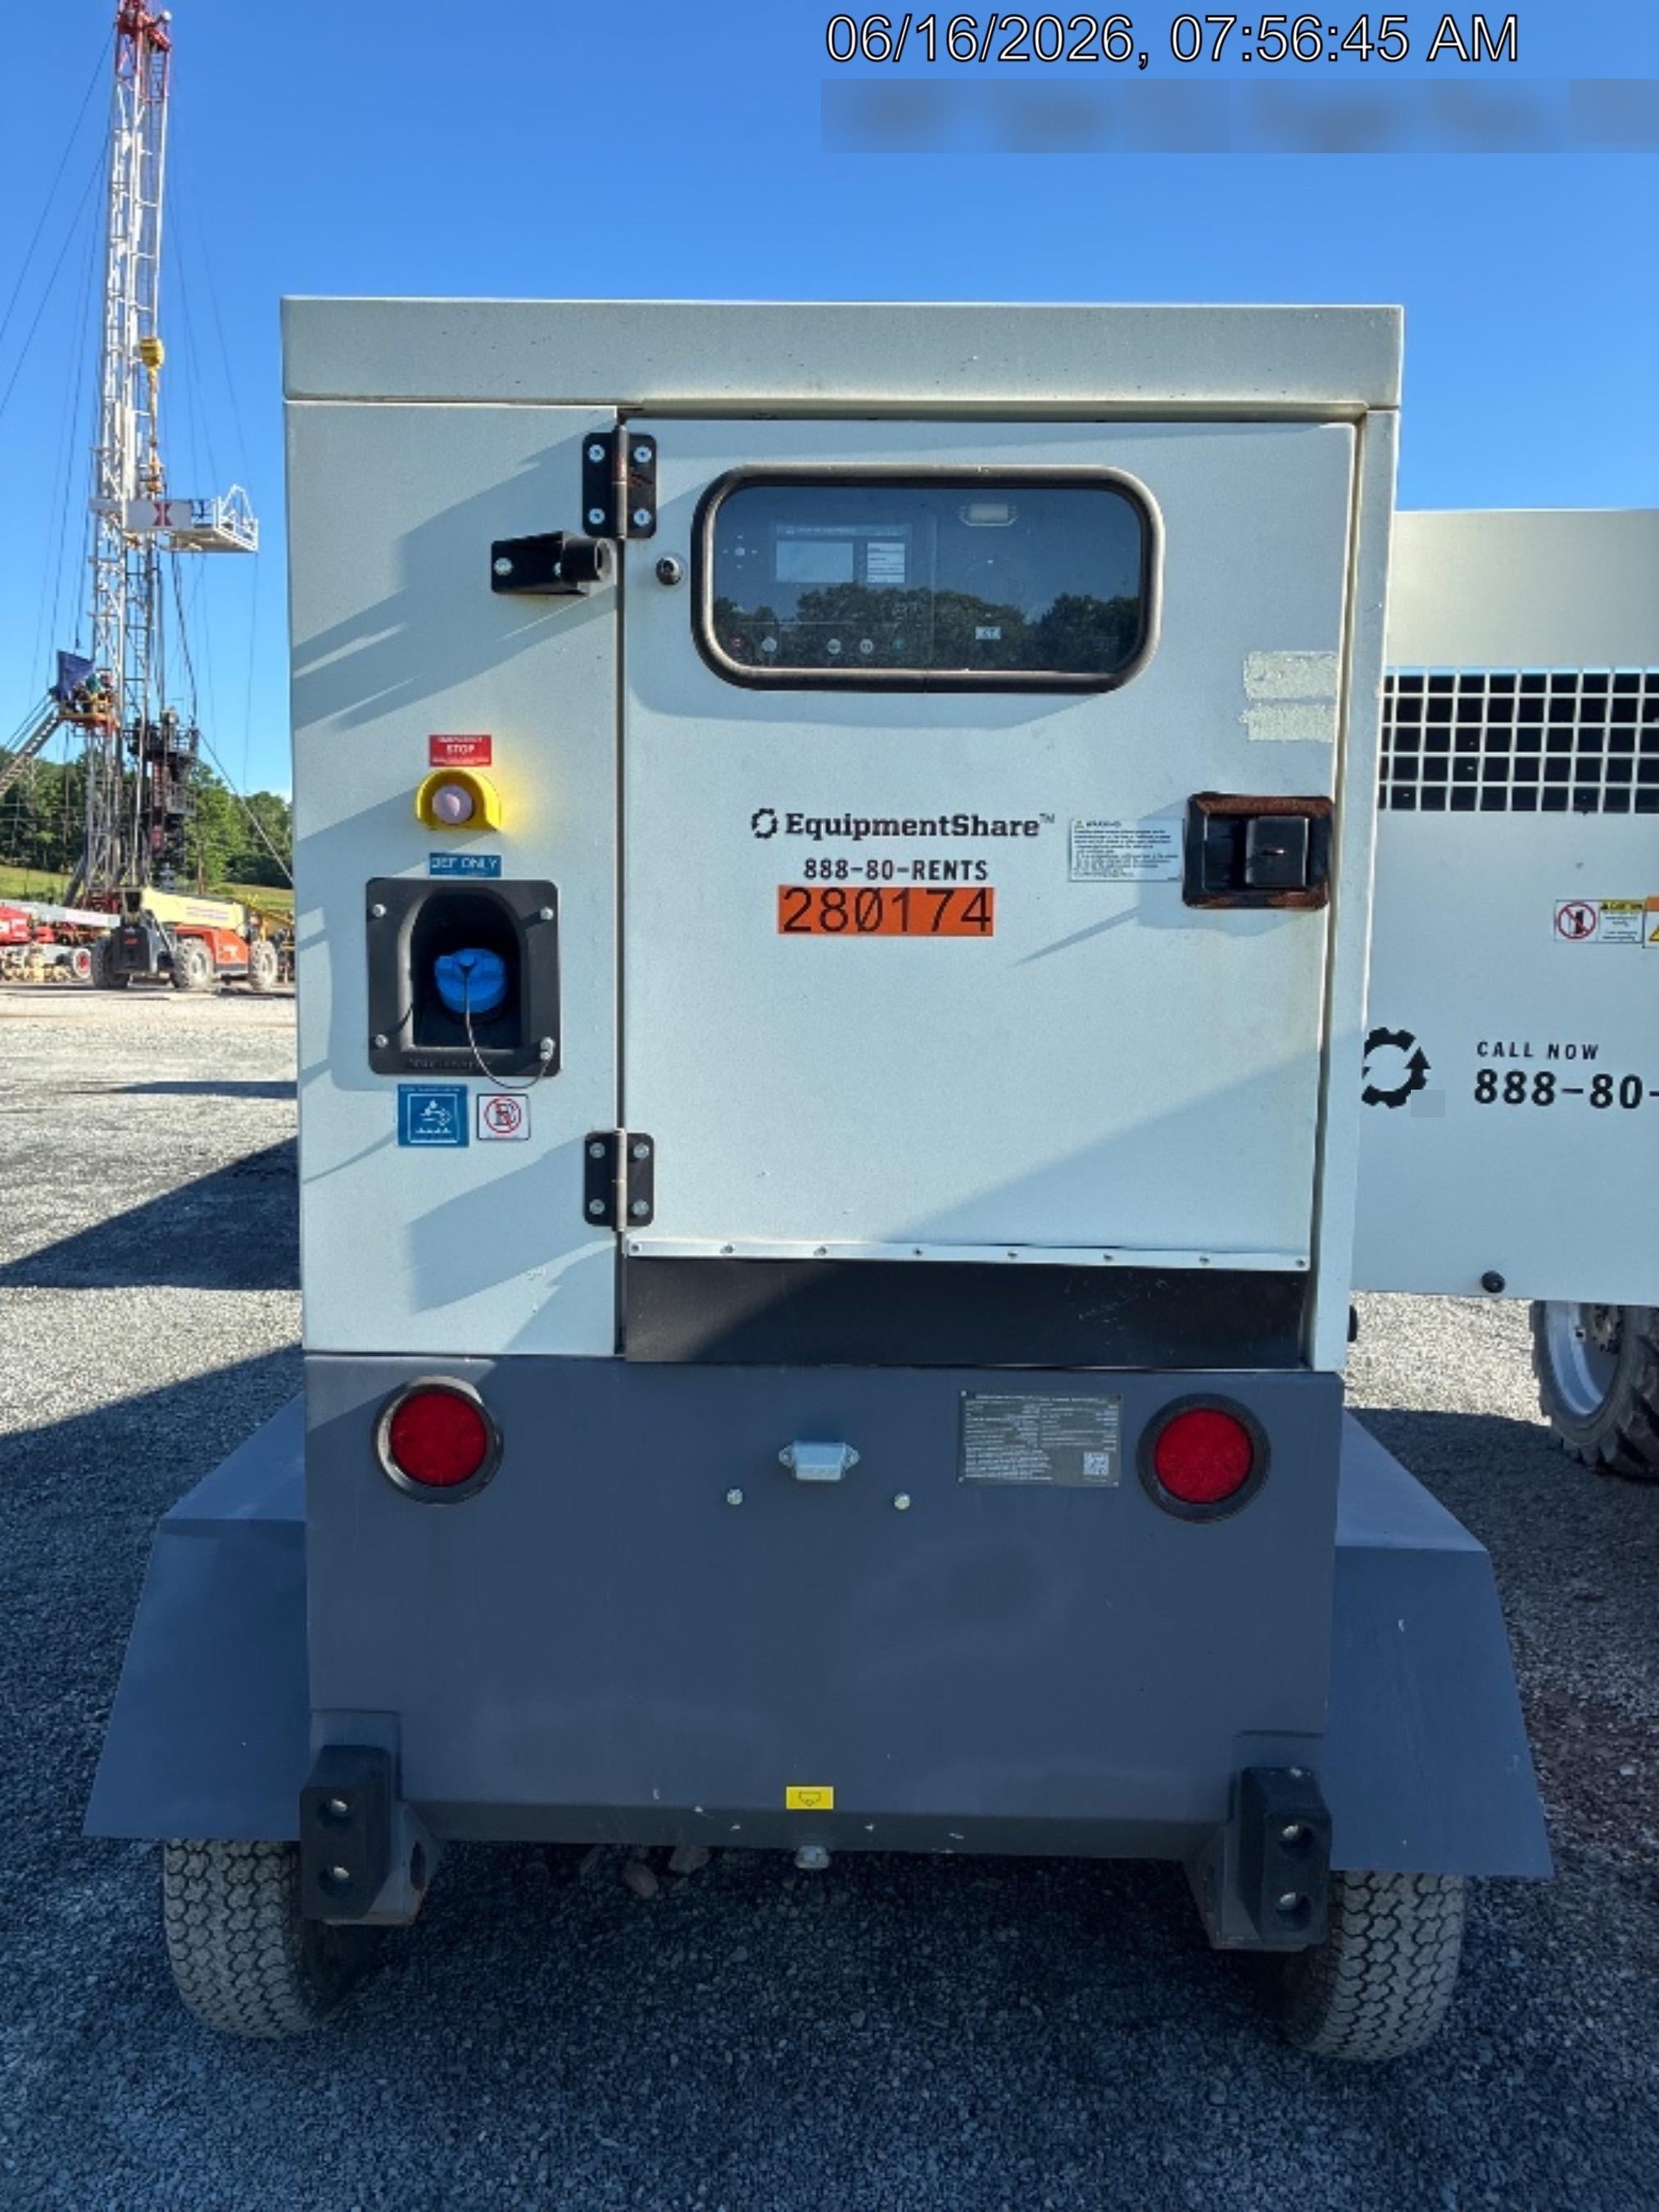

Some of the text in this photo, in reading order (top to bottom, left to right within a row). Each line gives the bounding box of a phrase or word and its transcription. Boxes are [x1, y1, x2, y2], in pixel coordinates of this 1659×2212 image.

[446, 744, 475, 755] STOP
[461, 857, 497, 871] ONLY
[803, 858, 988, 882] 888-80-RENTS
[782, 887, 991, 932] 280174
[1476, 1041, 1598, 1060] CALL NOW
